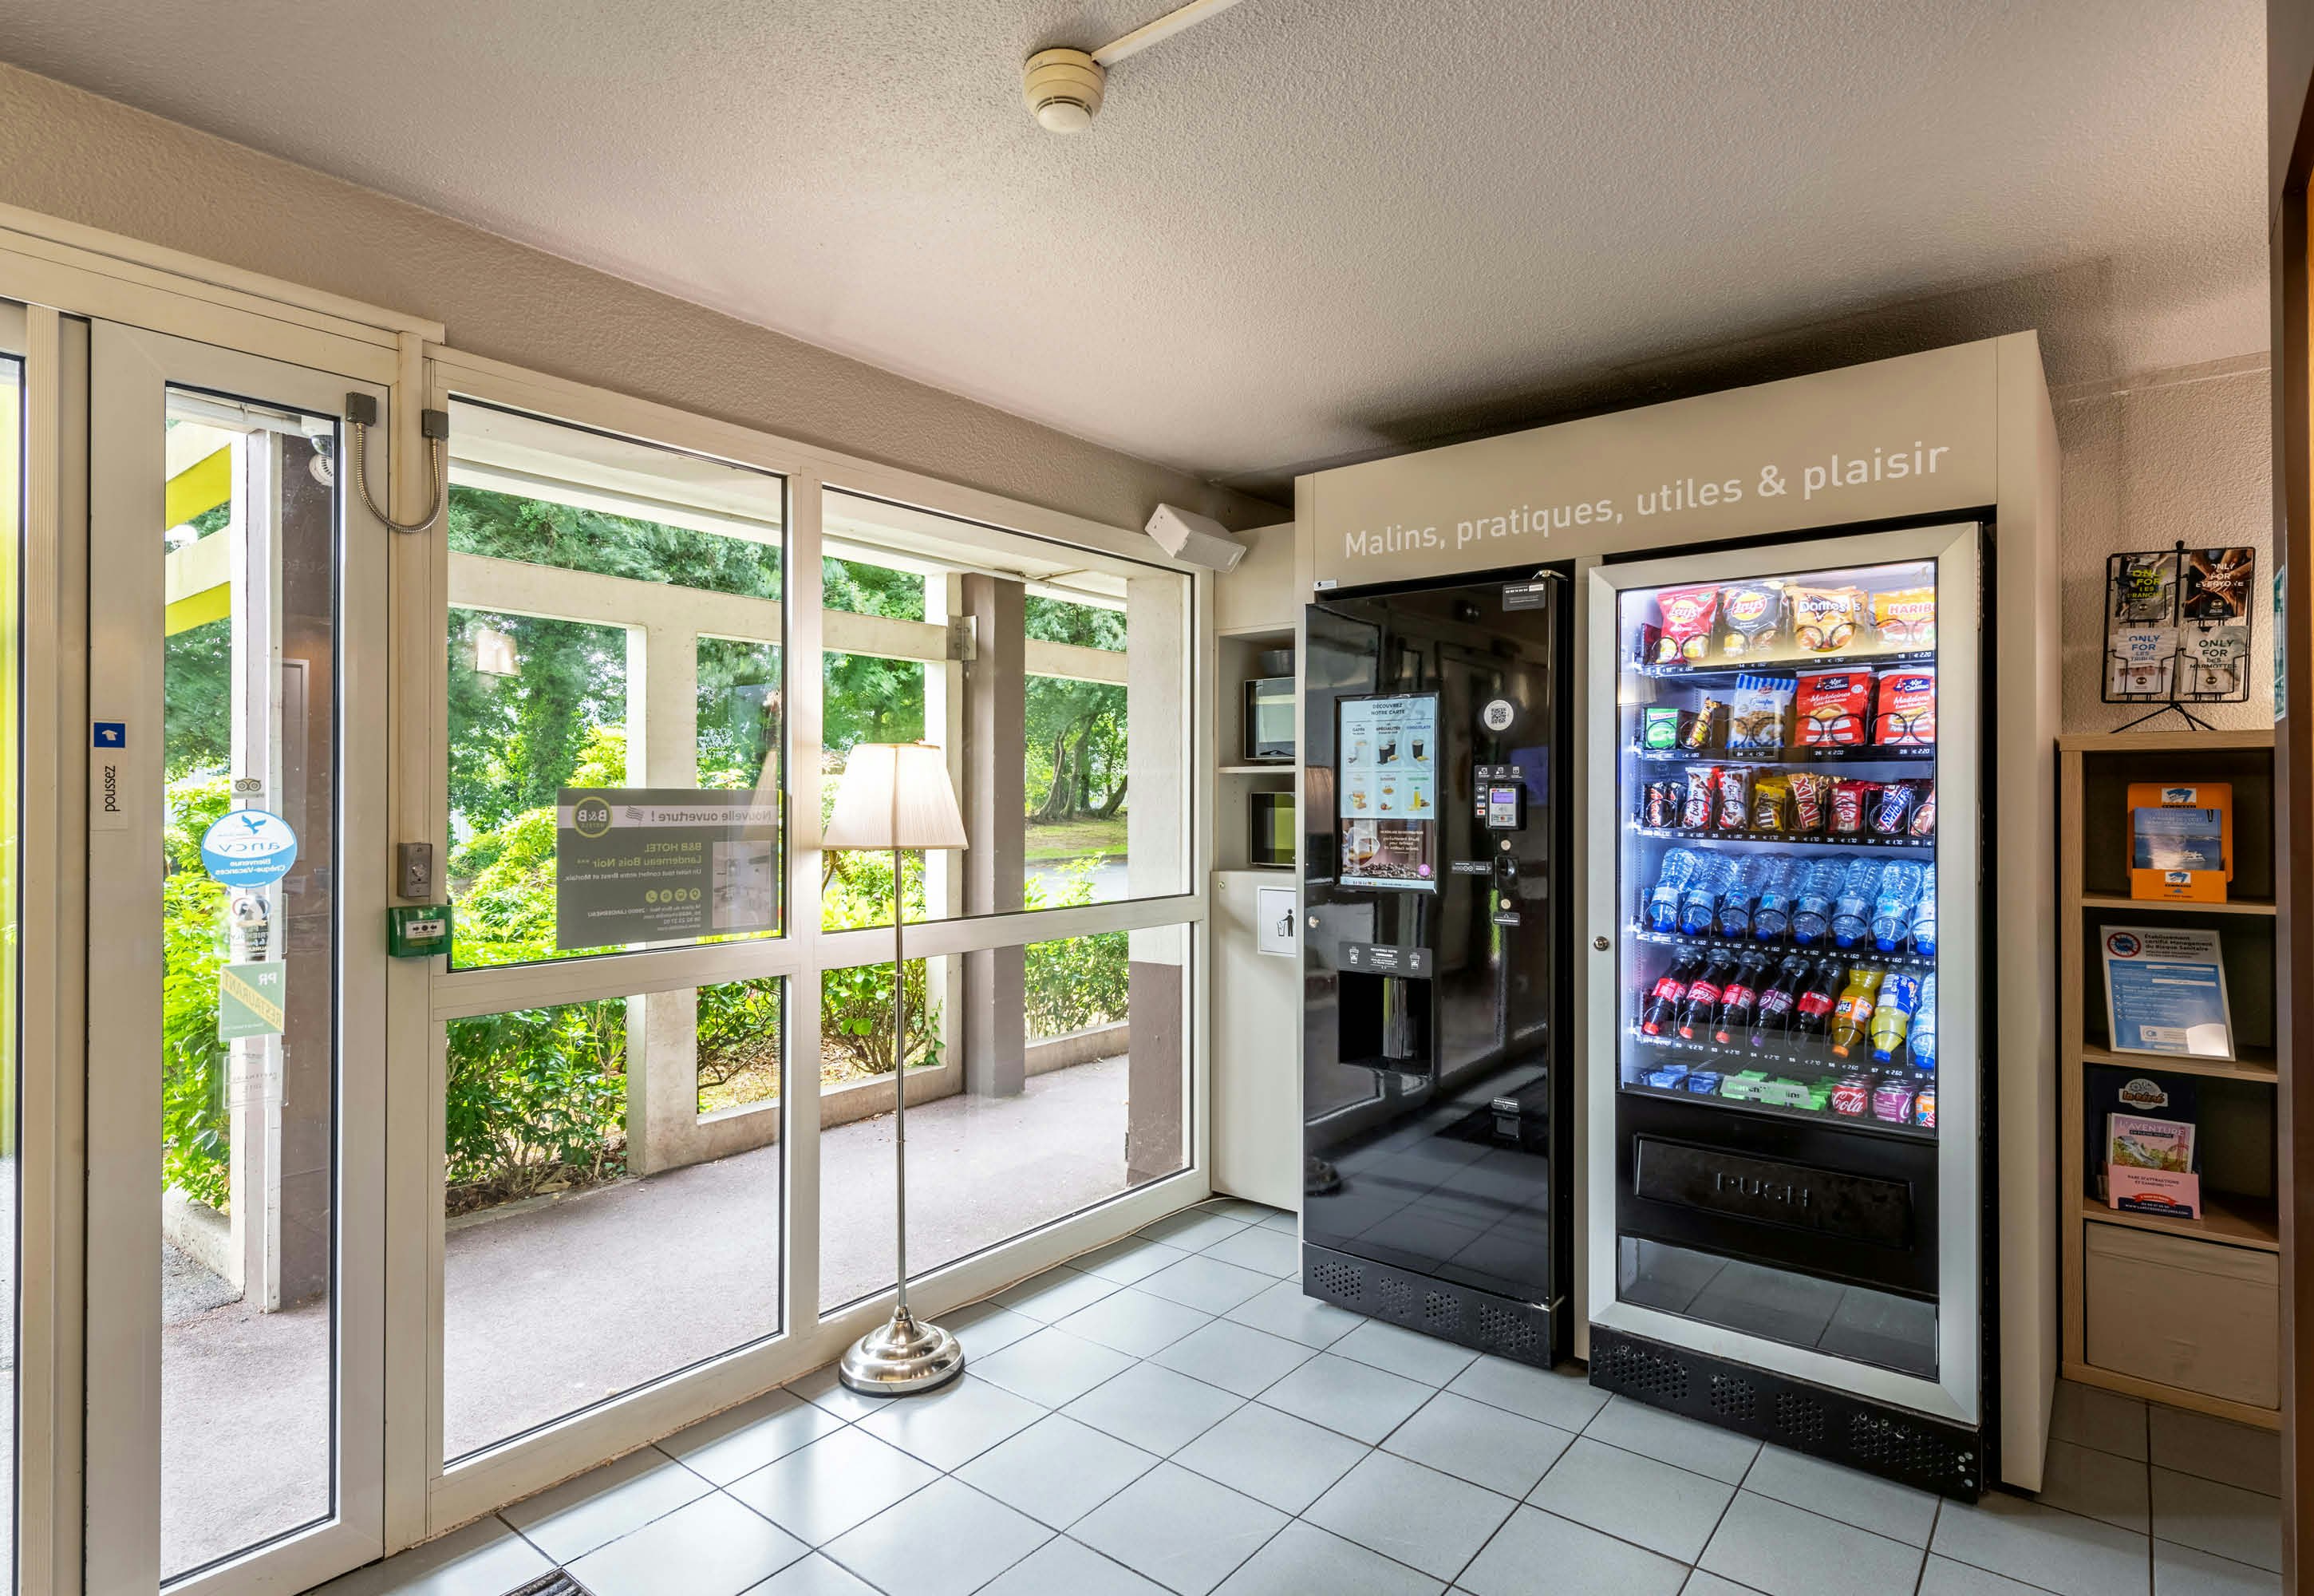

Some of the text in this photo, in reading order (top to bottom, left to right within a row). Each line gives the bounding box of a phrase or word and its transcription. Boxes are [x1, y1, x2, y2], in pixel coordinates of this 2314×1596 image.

[1345, 441, 1949, 559] Malins, pratiques, utiles & plaisir
[2198, 639, 2235, 648] ONLY
[105, 765, 121, 812] poussez
[2119, 1119, 2185, 1137] L'AVENTURE
